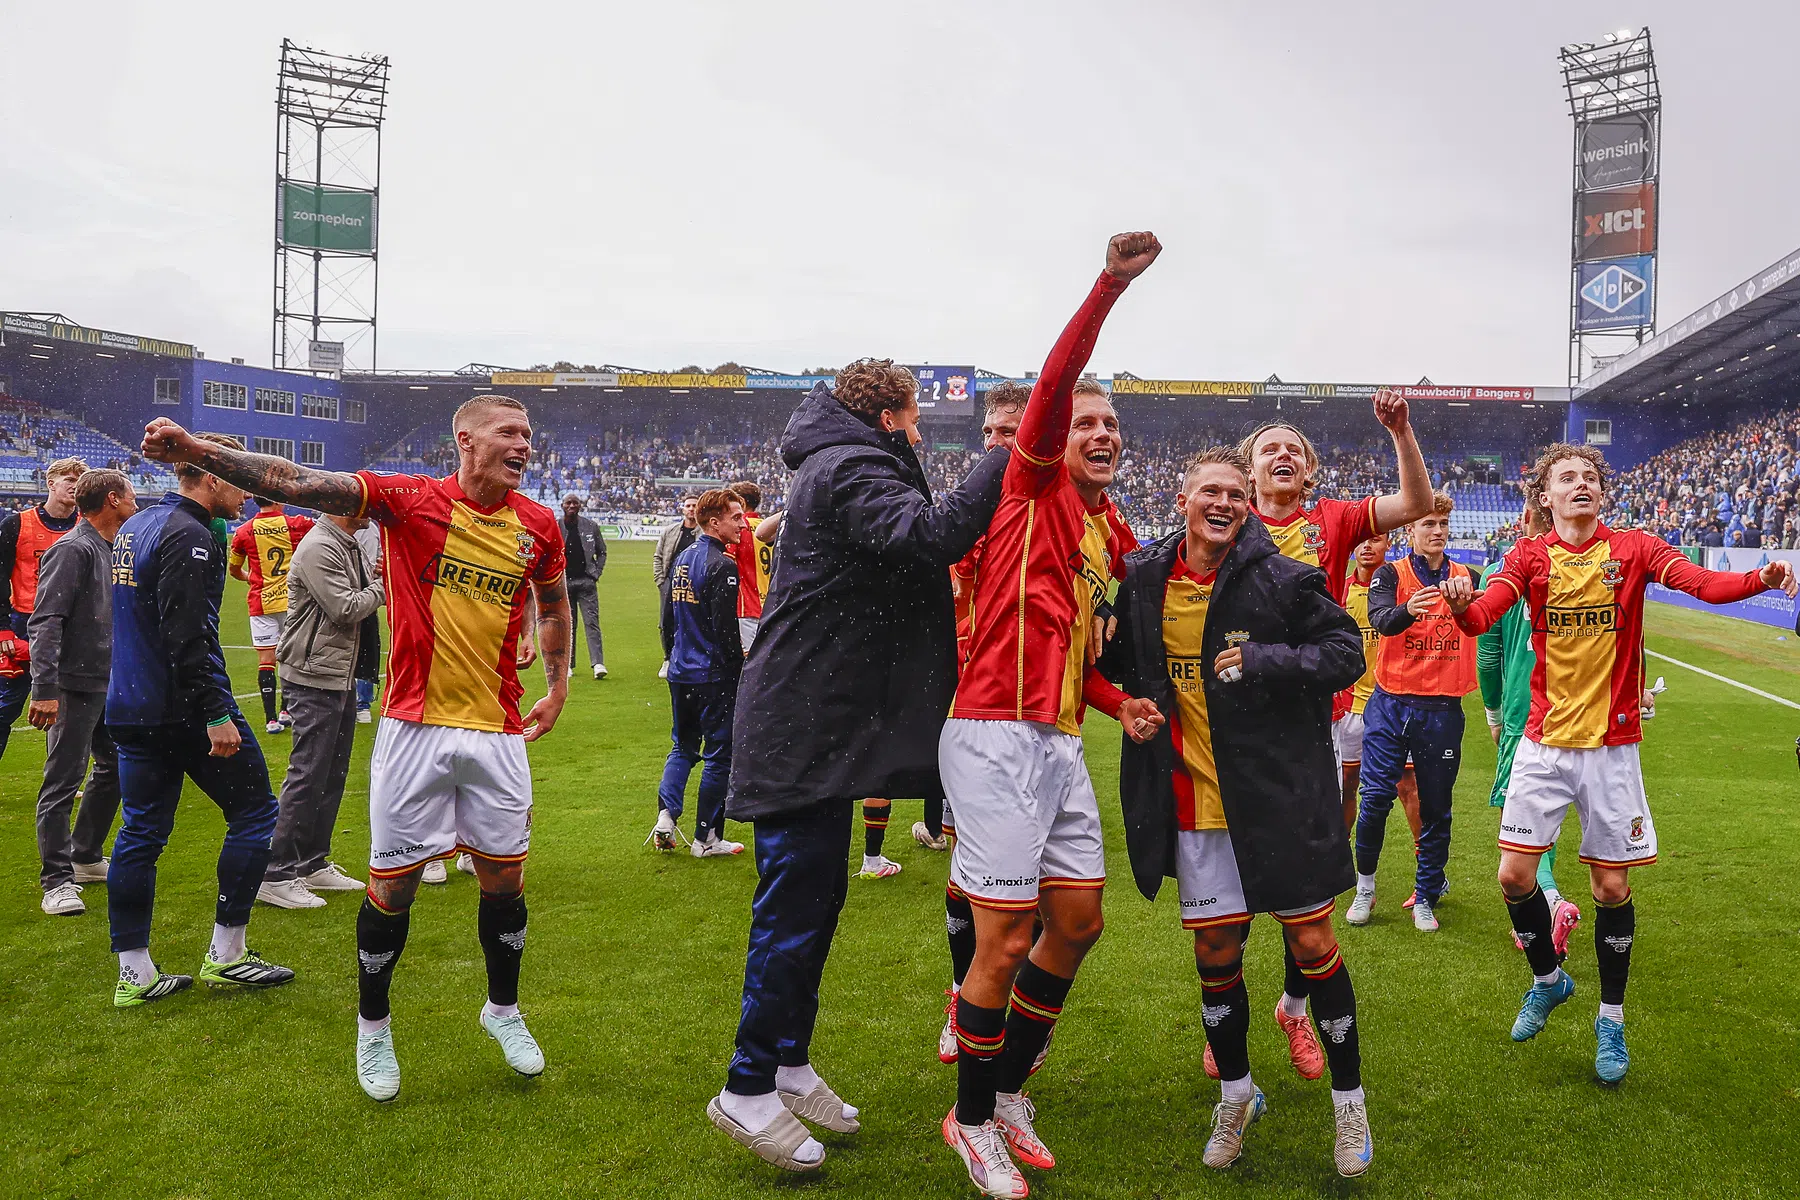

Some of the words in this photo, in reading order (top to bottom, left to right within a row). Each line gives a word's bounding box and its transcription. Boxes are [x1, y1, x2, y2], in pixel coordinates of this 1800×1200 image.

[1583, 137, 1650, 164] wensink
[4, 316, 47, 331] McDonald's
[101, 332, 138, 345] McDonald's
[747, 376, 811, 387] matchworks
[1266, 384, 1306, 392] McDonald's
[932, 380, 941, 401] 2
[1336, 385, 1377, 394] McDonald's
[1405, 387, 1472, 398] Bouwbedrijf
[1476, 388, 1520, 399] Bongers
[267, 547, 287, 577] 2
[760, 546, 771, 575] 9
[441, 562, 518, 596] RETRO
[449, 584, 498, 605] BRIDGE
[1549, 609, 1612, 626] RETRO
[1558, 628, 1600, 638] BRIDGE
[1405, 634, 1460, 650] Salland
[1517, 827, 1532, 835] zoo
[380, 846, 404, 859] maxi
[405, 843, 424, 854] zoo
[995, 876, 1023, 887] maxi
[1198, 897, 1217, 907] zoo
